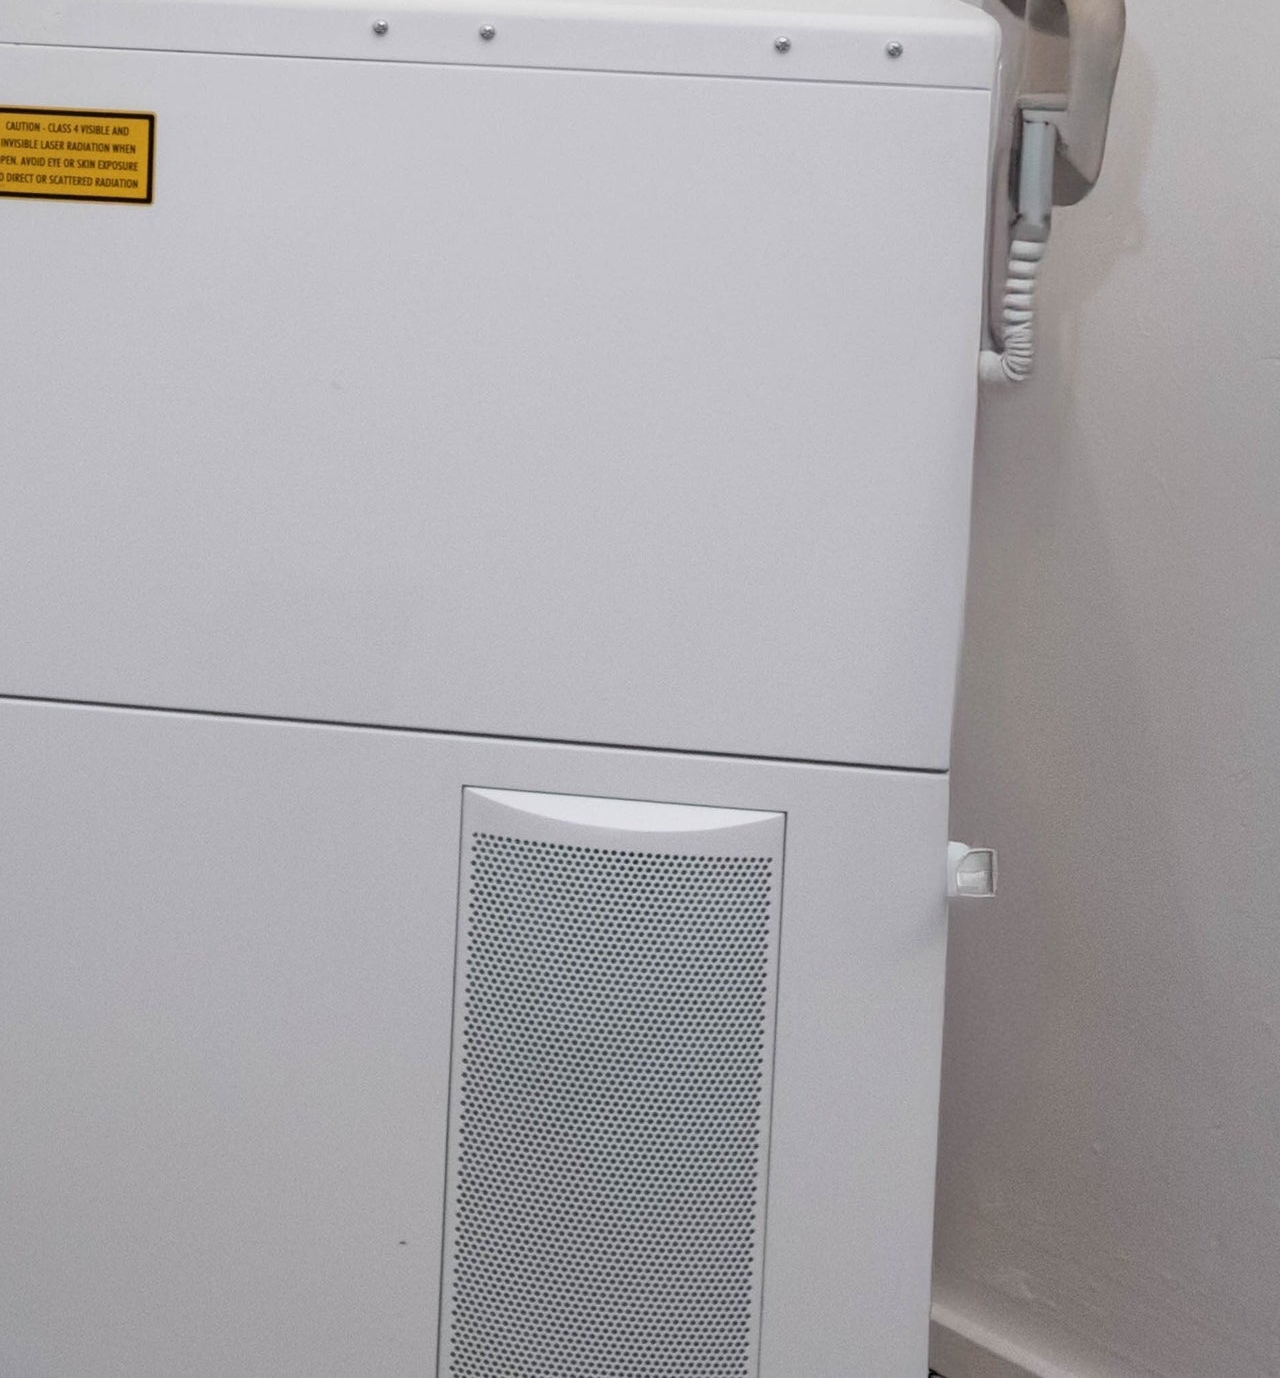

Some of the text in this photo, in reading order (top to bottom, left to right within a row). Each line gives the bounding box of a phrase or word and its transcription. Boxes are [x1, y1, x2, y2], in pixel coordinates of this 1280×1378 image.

[5, 121, 40, 132] CAUTION
[48, 123, 72, 134] CLASS
[73, 124, 79, 134] 4
[81, 124, 110, 136] VISIBLE
[112, 126, 130, 137] AND
[0, 138, 136, 154] INVISIBLE LASER RADIATION WHEN
[20, 156, 46, 167] AVOID
[48, 158, 61, 168] EYE
[63, 158, 75, 168] OR
[77, 159, 96, 170] SKIN
[98, 160, 139, 172] EXPOSURE
[6, 173, 34, 183] DIRECT
[36, 174, 47, 184] OR
[49, 175, 93, 187] SCATTERED
[95, 177, 139, 189] RADIATION
